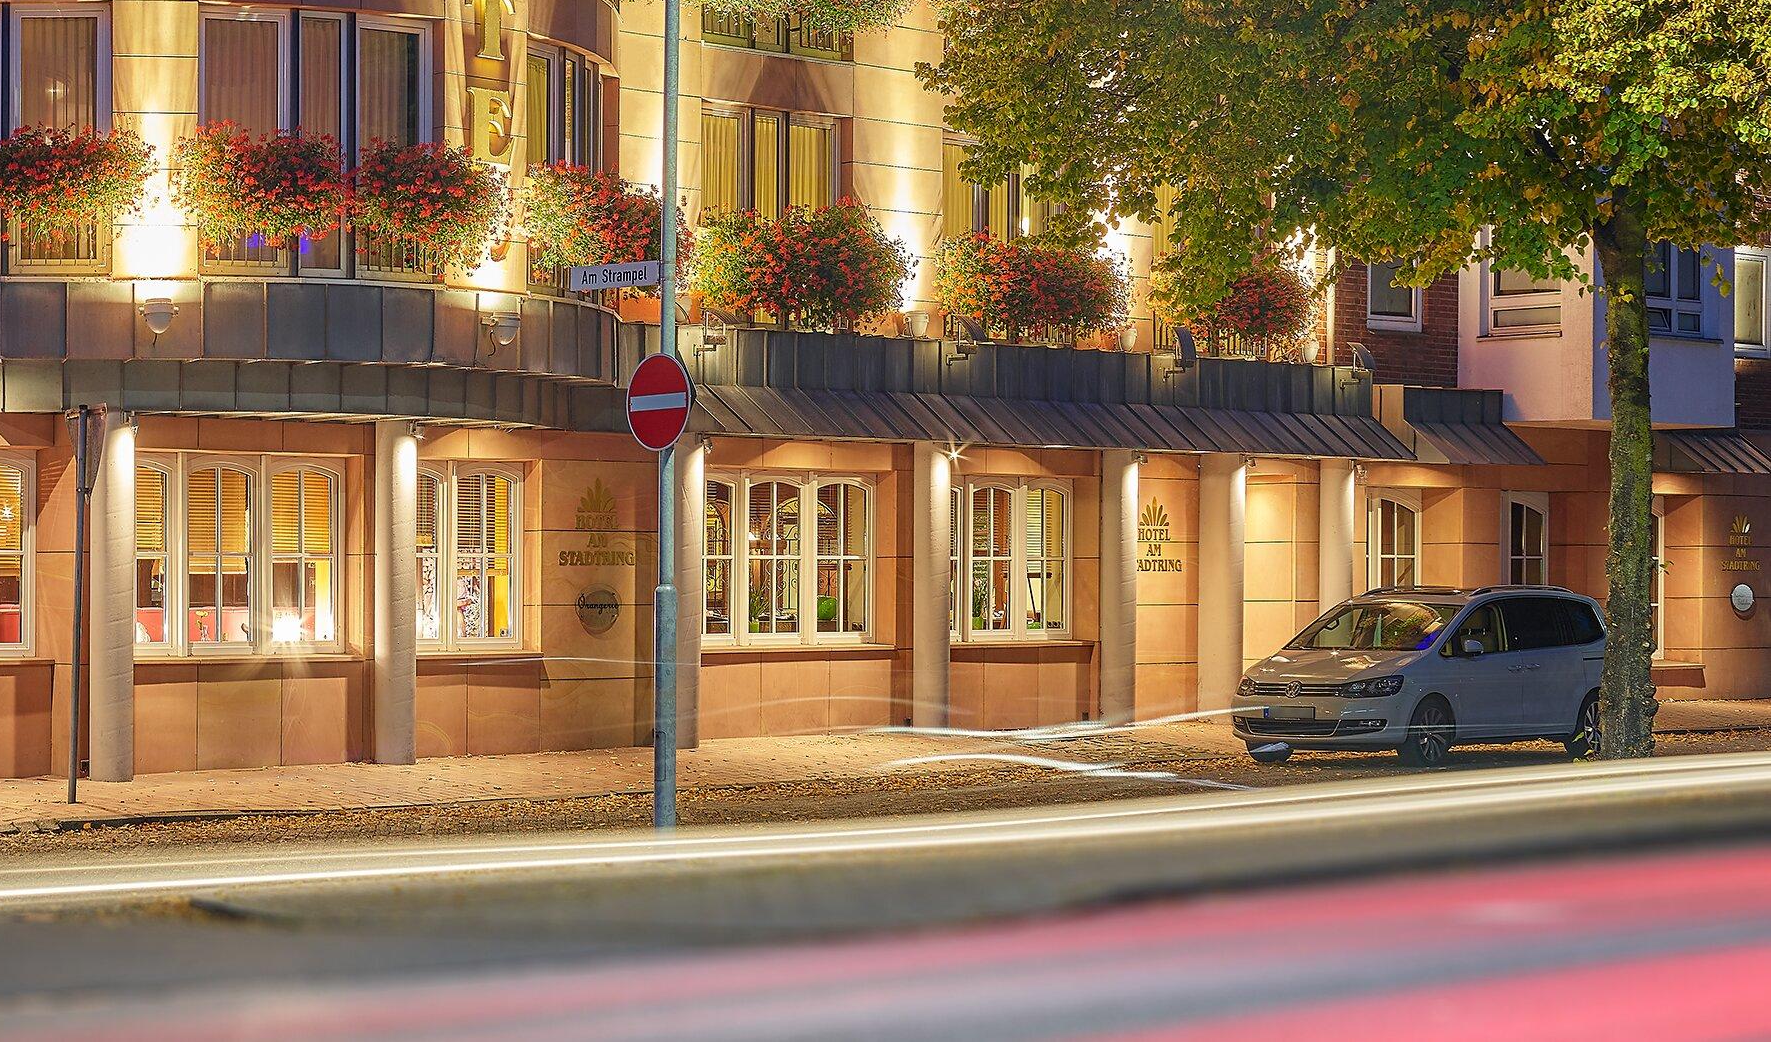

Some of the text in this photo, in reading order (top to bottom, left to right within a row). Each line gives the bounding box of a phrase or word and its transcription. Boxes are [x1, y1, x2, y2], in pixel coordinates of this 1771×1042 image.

[581, 266, 647, 285] Am Strampel
[575, 514, 619, 530] HOTEL
[1137, 528, 1171, 541] HOTEL
[1146, 543, 1162, 557] AM
[558, 550, 636, 567] STADTRING
[1136, 559, 1183, 572] ADTRING
[577, 593, 620, 615] Orangerie
